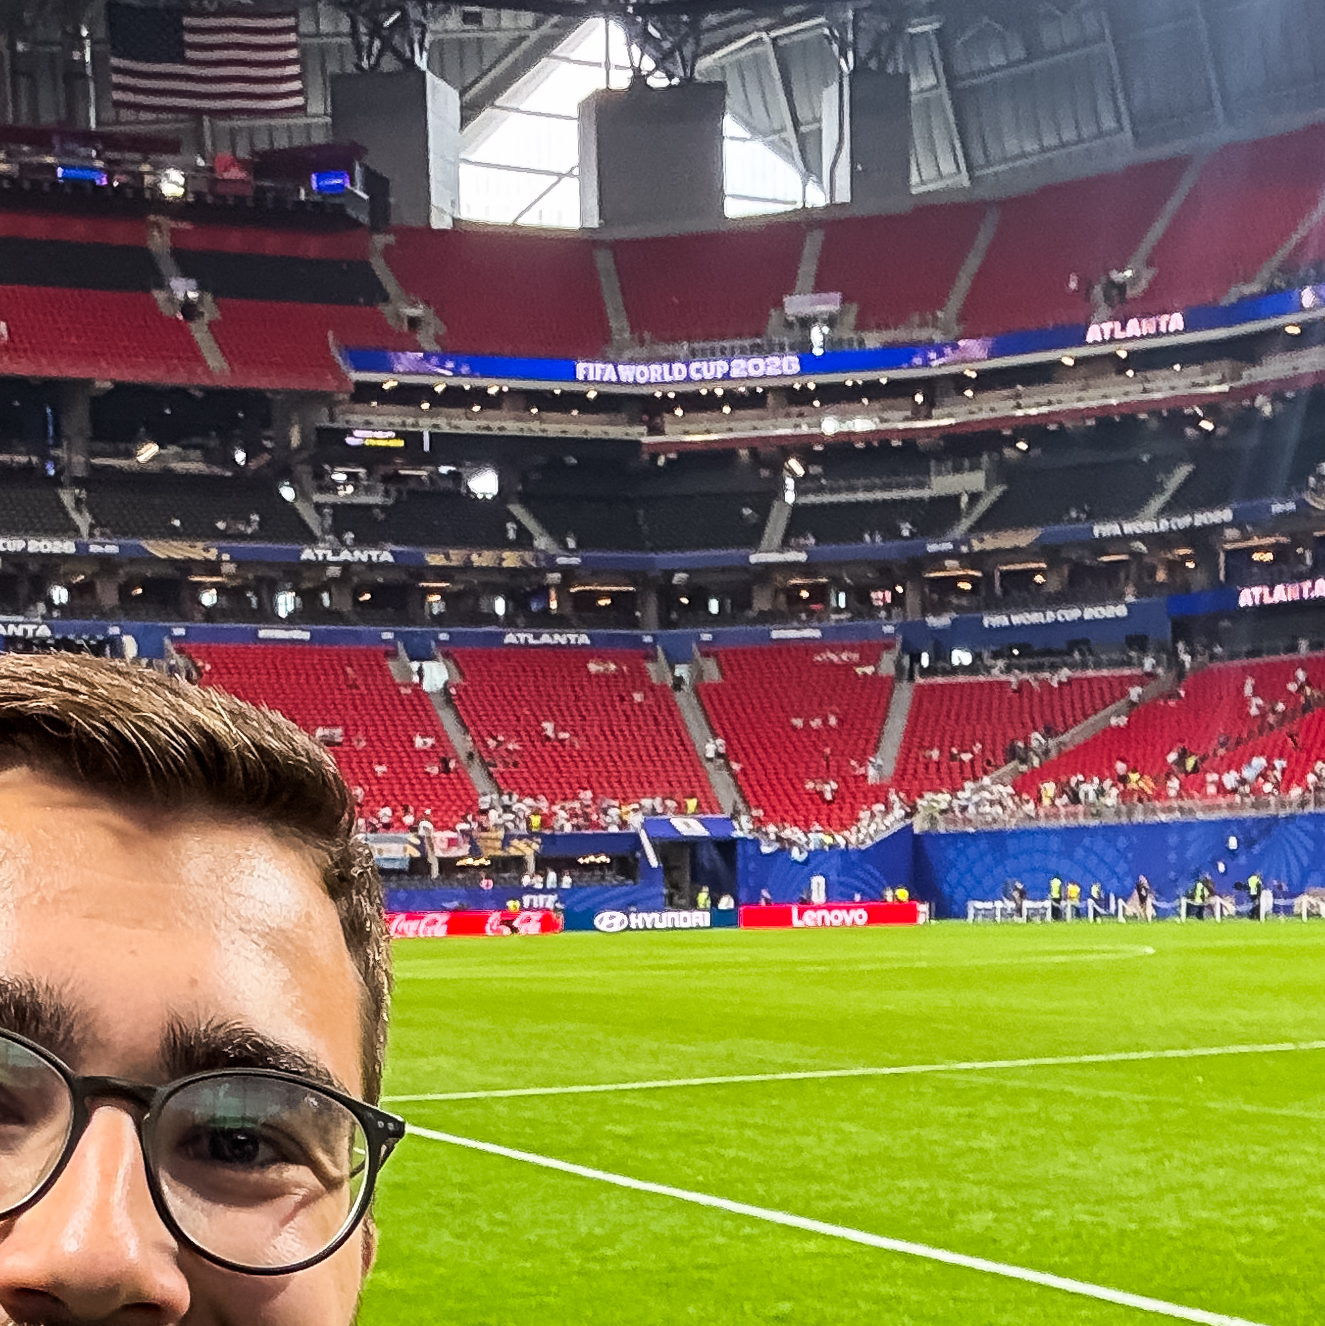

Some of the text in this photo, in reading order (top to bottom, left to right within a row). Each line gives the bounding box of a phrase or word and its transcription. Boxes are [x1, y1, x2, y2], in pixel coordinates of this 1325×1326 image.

[1085, 312, 1185, 344] ATLANTA
[575, 362, 619, 382] FIFA
[617, 363, 687, 384] WORLD
[688, 360, 729, 380] CUP
[299, 548, 395, 563] ATLANTA
[503, 632, 591, 646] ATLANTA
[628, 909, 712, 930] HYUNDAI
[790, 906, 870, 929] Lenovo
